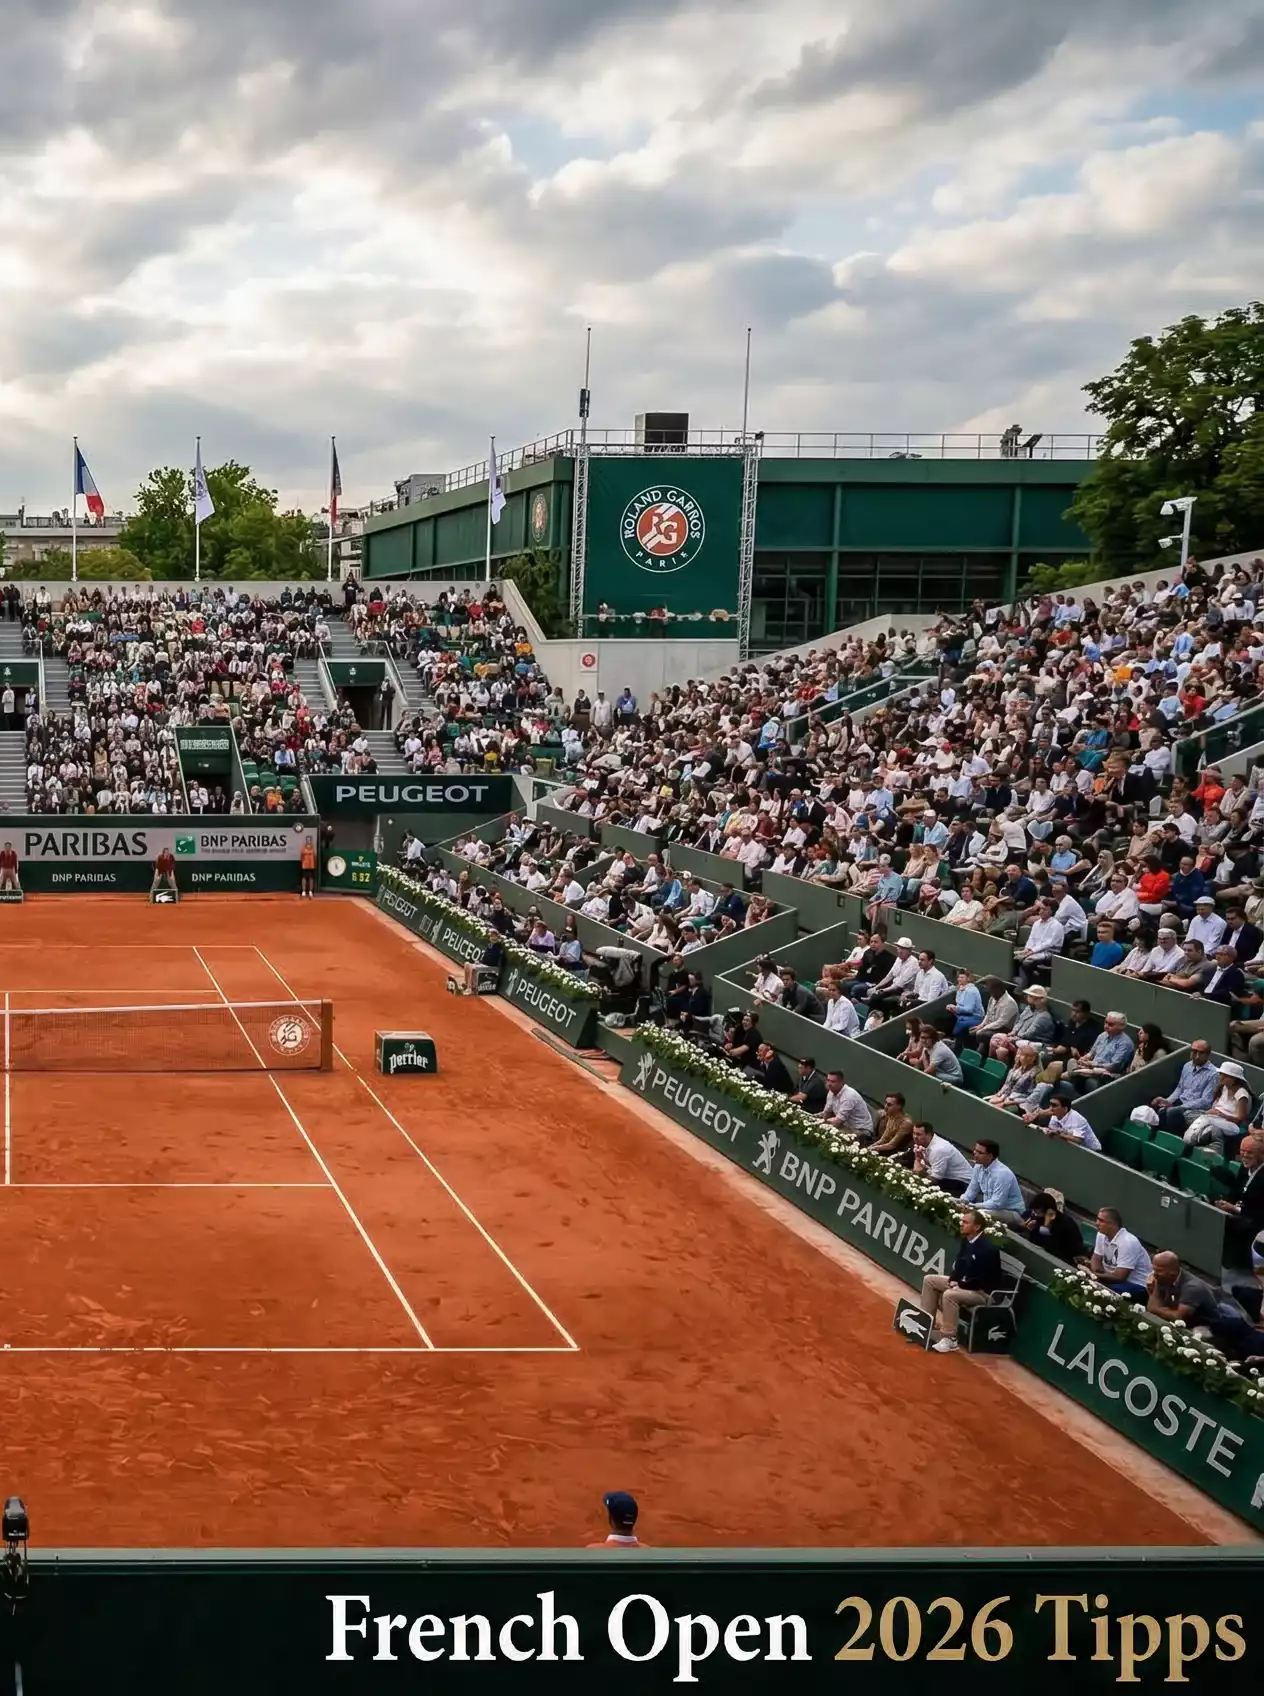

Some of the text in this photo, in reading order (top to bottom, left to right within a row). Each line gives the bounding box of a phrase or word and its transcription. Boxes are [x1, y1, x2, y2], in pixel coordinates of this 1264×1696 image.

[336, 785, 489, 803] PEUGEOT
[24, 832, 148, 857] PARIBAS
[200, 835, 287, 847] BNP PARIBAS
[516, 979, 577, 1028] PEUGEOT
[389, 1049, 428, 1074] perrier
[651, 1067, 746, 1142] PEUGEOT
[779, 1150, 955, 1276] BNP PARIBA
[1046, 1323, 1244, 1478] LACOSTE
